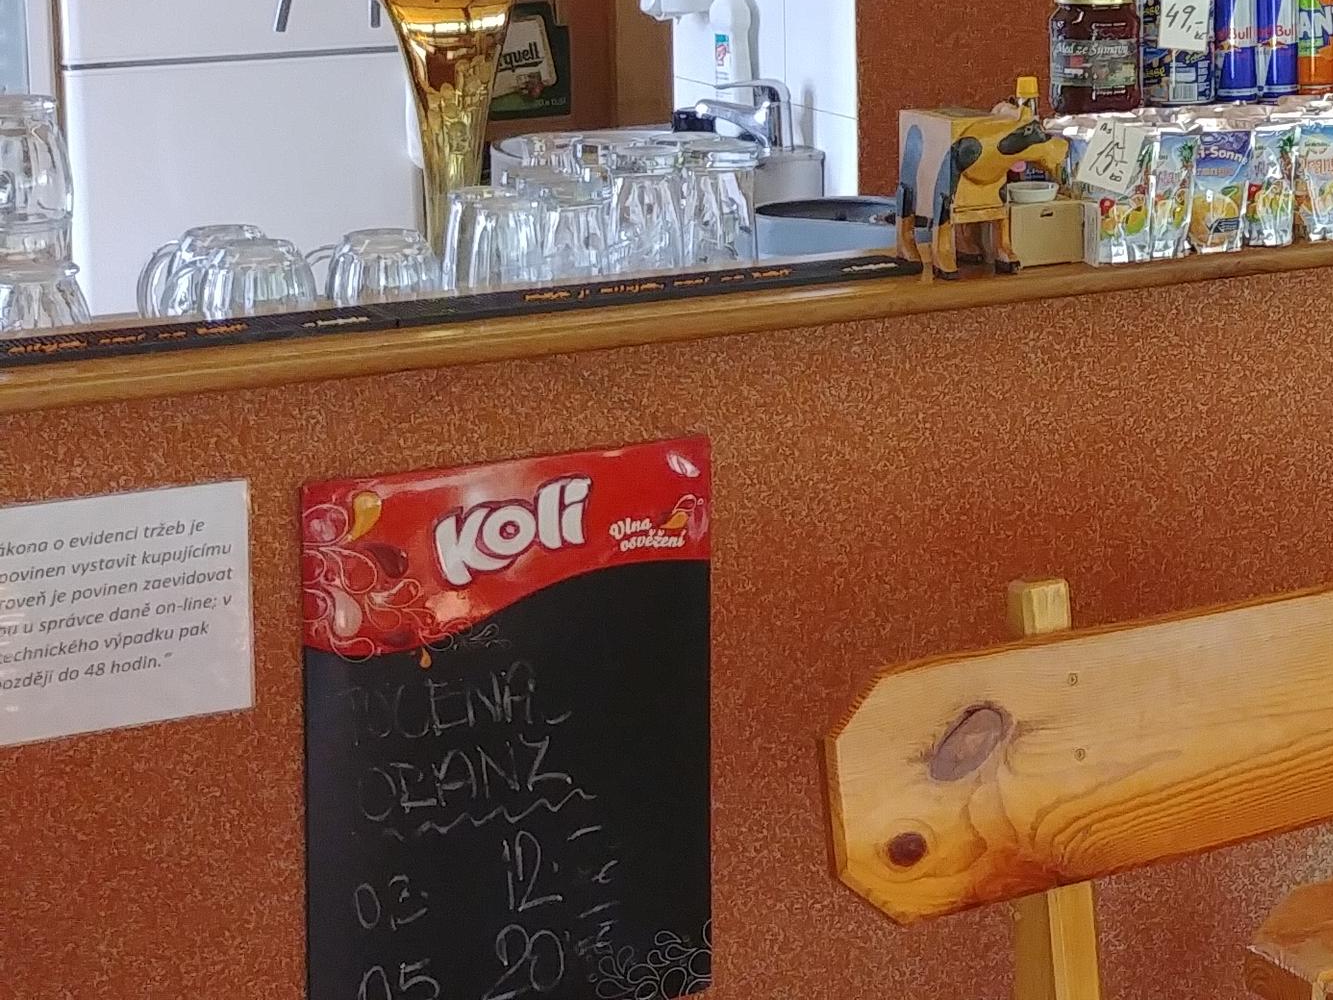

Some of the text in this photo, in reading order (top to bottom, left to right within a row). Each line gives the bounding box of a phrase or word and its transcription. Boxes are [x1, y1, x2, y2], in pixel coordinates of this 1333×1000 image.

[499, 41, 541, 73] quell
[0, 520, 206, 558] ákona o evidenci tržeb je
[609, 516, 653, 541] Vlna
[620, 526, 687, 552] osvěžení
[72, 553, 137, 576] vystavit
[141, 542, 233, 567] kupujícímu
[0, 567, 233, 611] oveň je povinen zaevidovat
[23, 624, 34, 636] u
[39, 612, 105, 635] správce
[109, 604, 152, 624] daně
[155, 596, 219, 616] on-line;
[223, 594, 233, 607] v
[104, 626, 174, 651] výpadku
[178, 620, 210, 642] pak
[0, 670, 53, 691] ozději
[58, 667, 80, 683] do
[84, 661, 106, 678] 48
